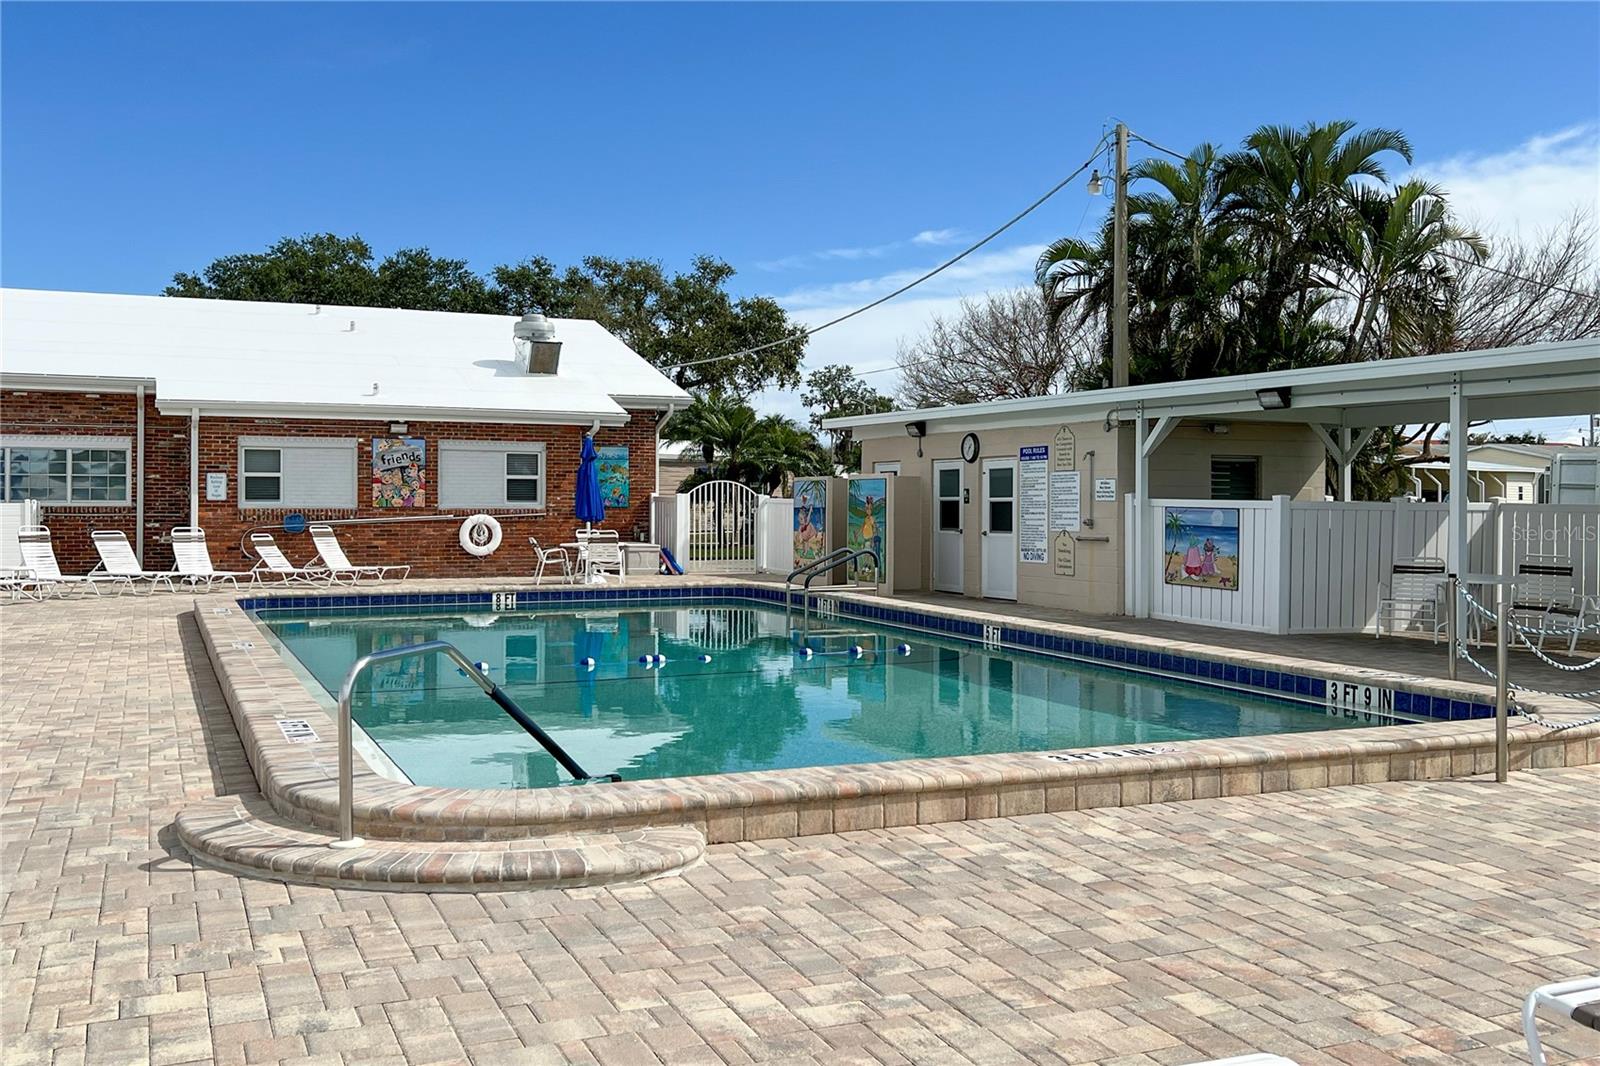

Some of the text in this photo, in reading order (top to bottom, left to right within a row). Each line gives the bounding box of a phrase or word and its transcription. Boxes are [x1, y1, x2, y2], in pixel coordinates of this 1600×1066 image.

[381, 452, 422, 466] friends
[1023, 552, 1045, 561] NO DIVING
[505, 593, 515, 603] FT
[1331, 682, 1392, 710] 3 FT 9 IN
